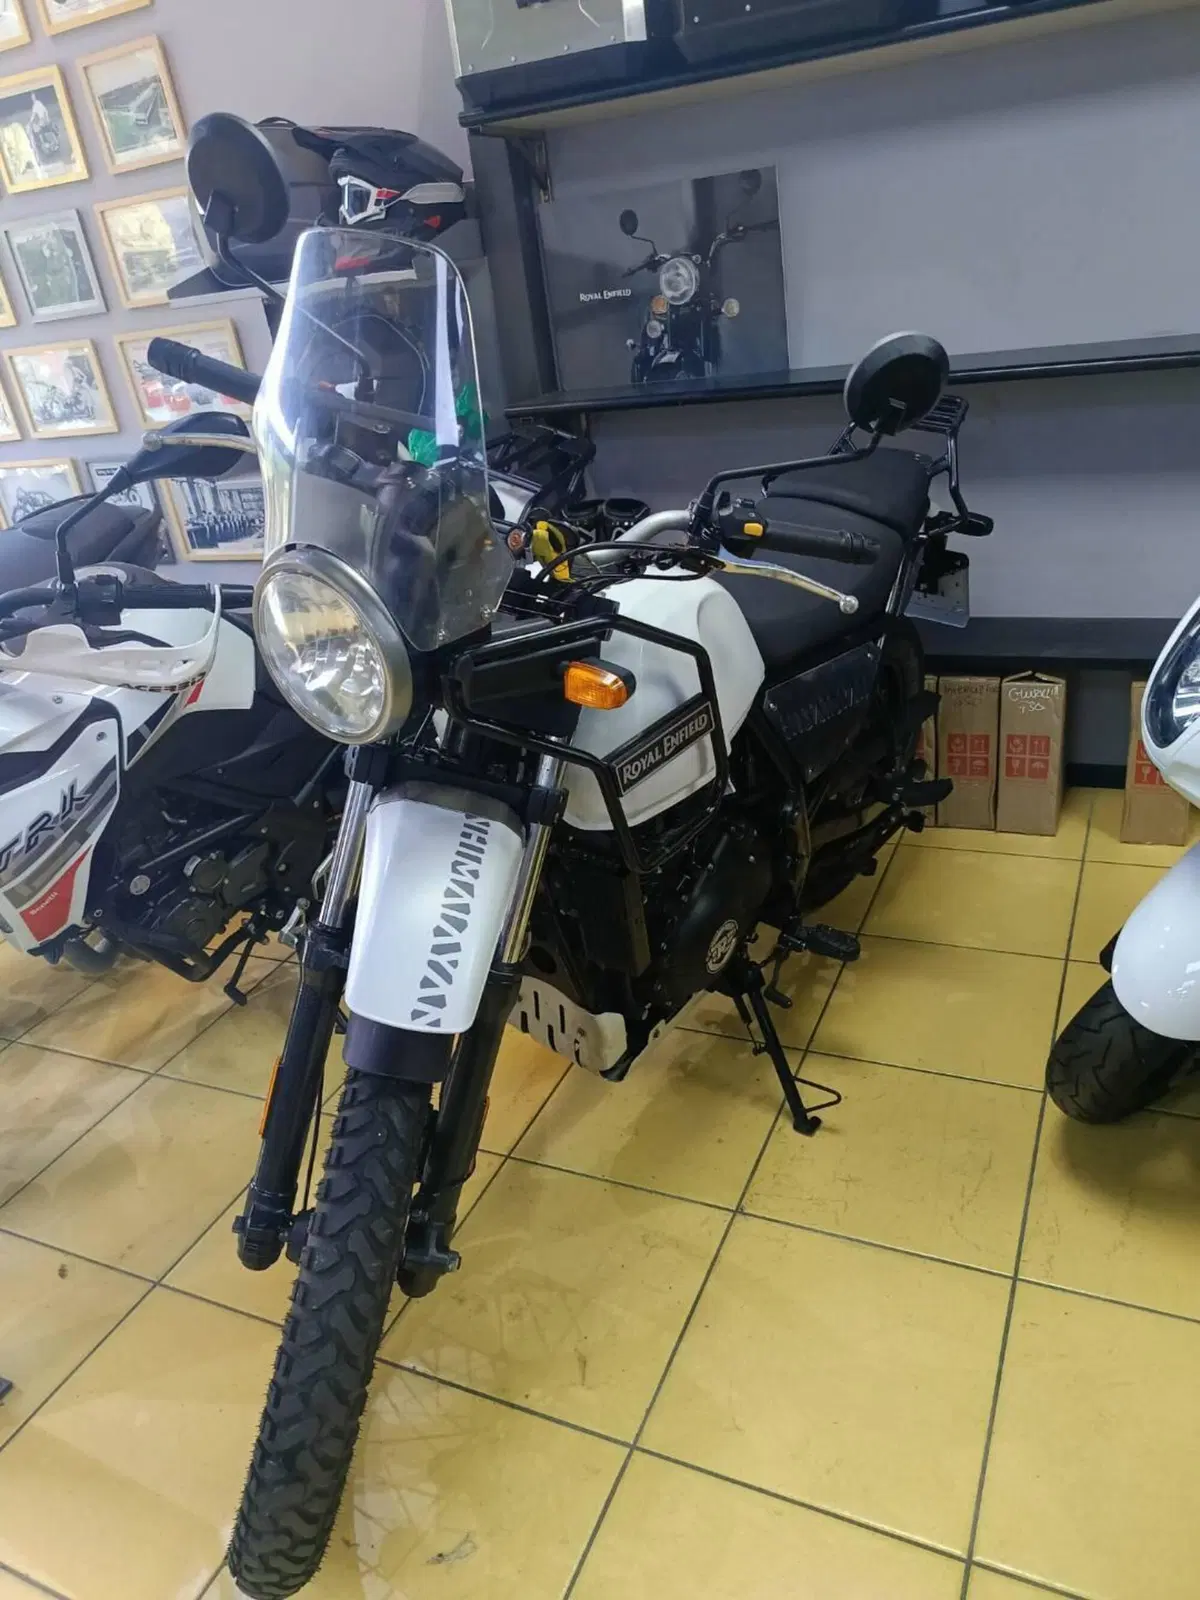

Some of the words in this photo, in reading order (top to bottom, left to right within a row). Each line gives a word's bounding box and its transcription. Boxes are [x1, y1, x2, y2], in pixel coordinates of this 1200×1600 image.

[580, 292, 602, 302] ROYAL
[603, 289, 632, 300] ENFIELD
[622, 747, 662, 785] ROYAL
[663, 713, 709, 757] ENFIELD
